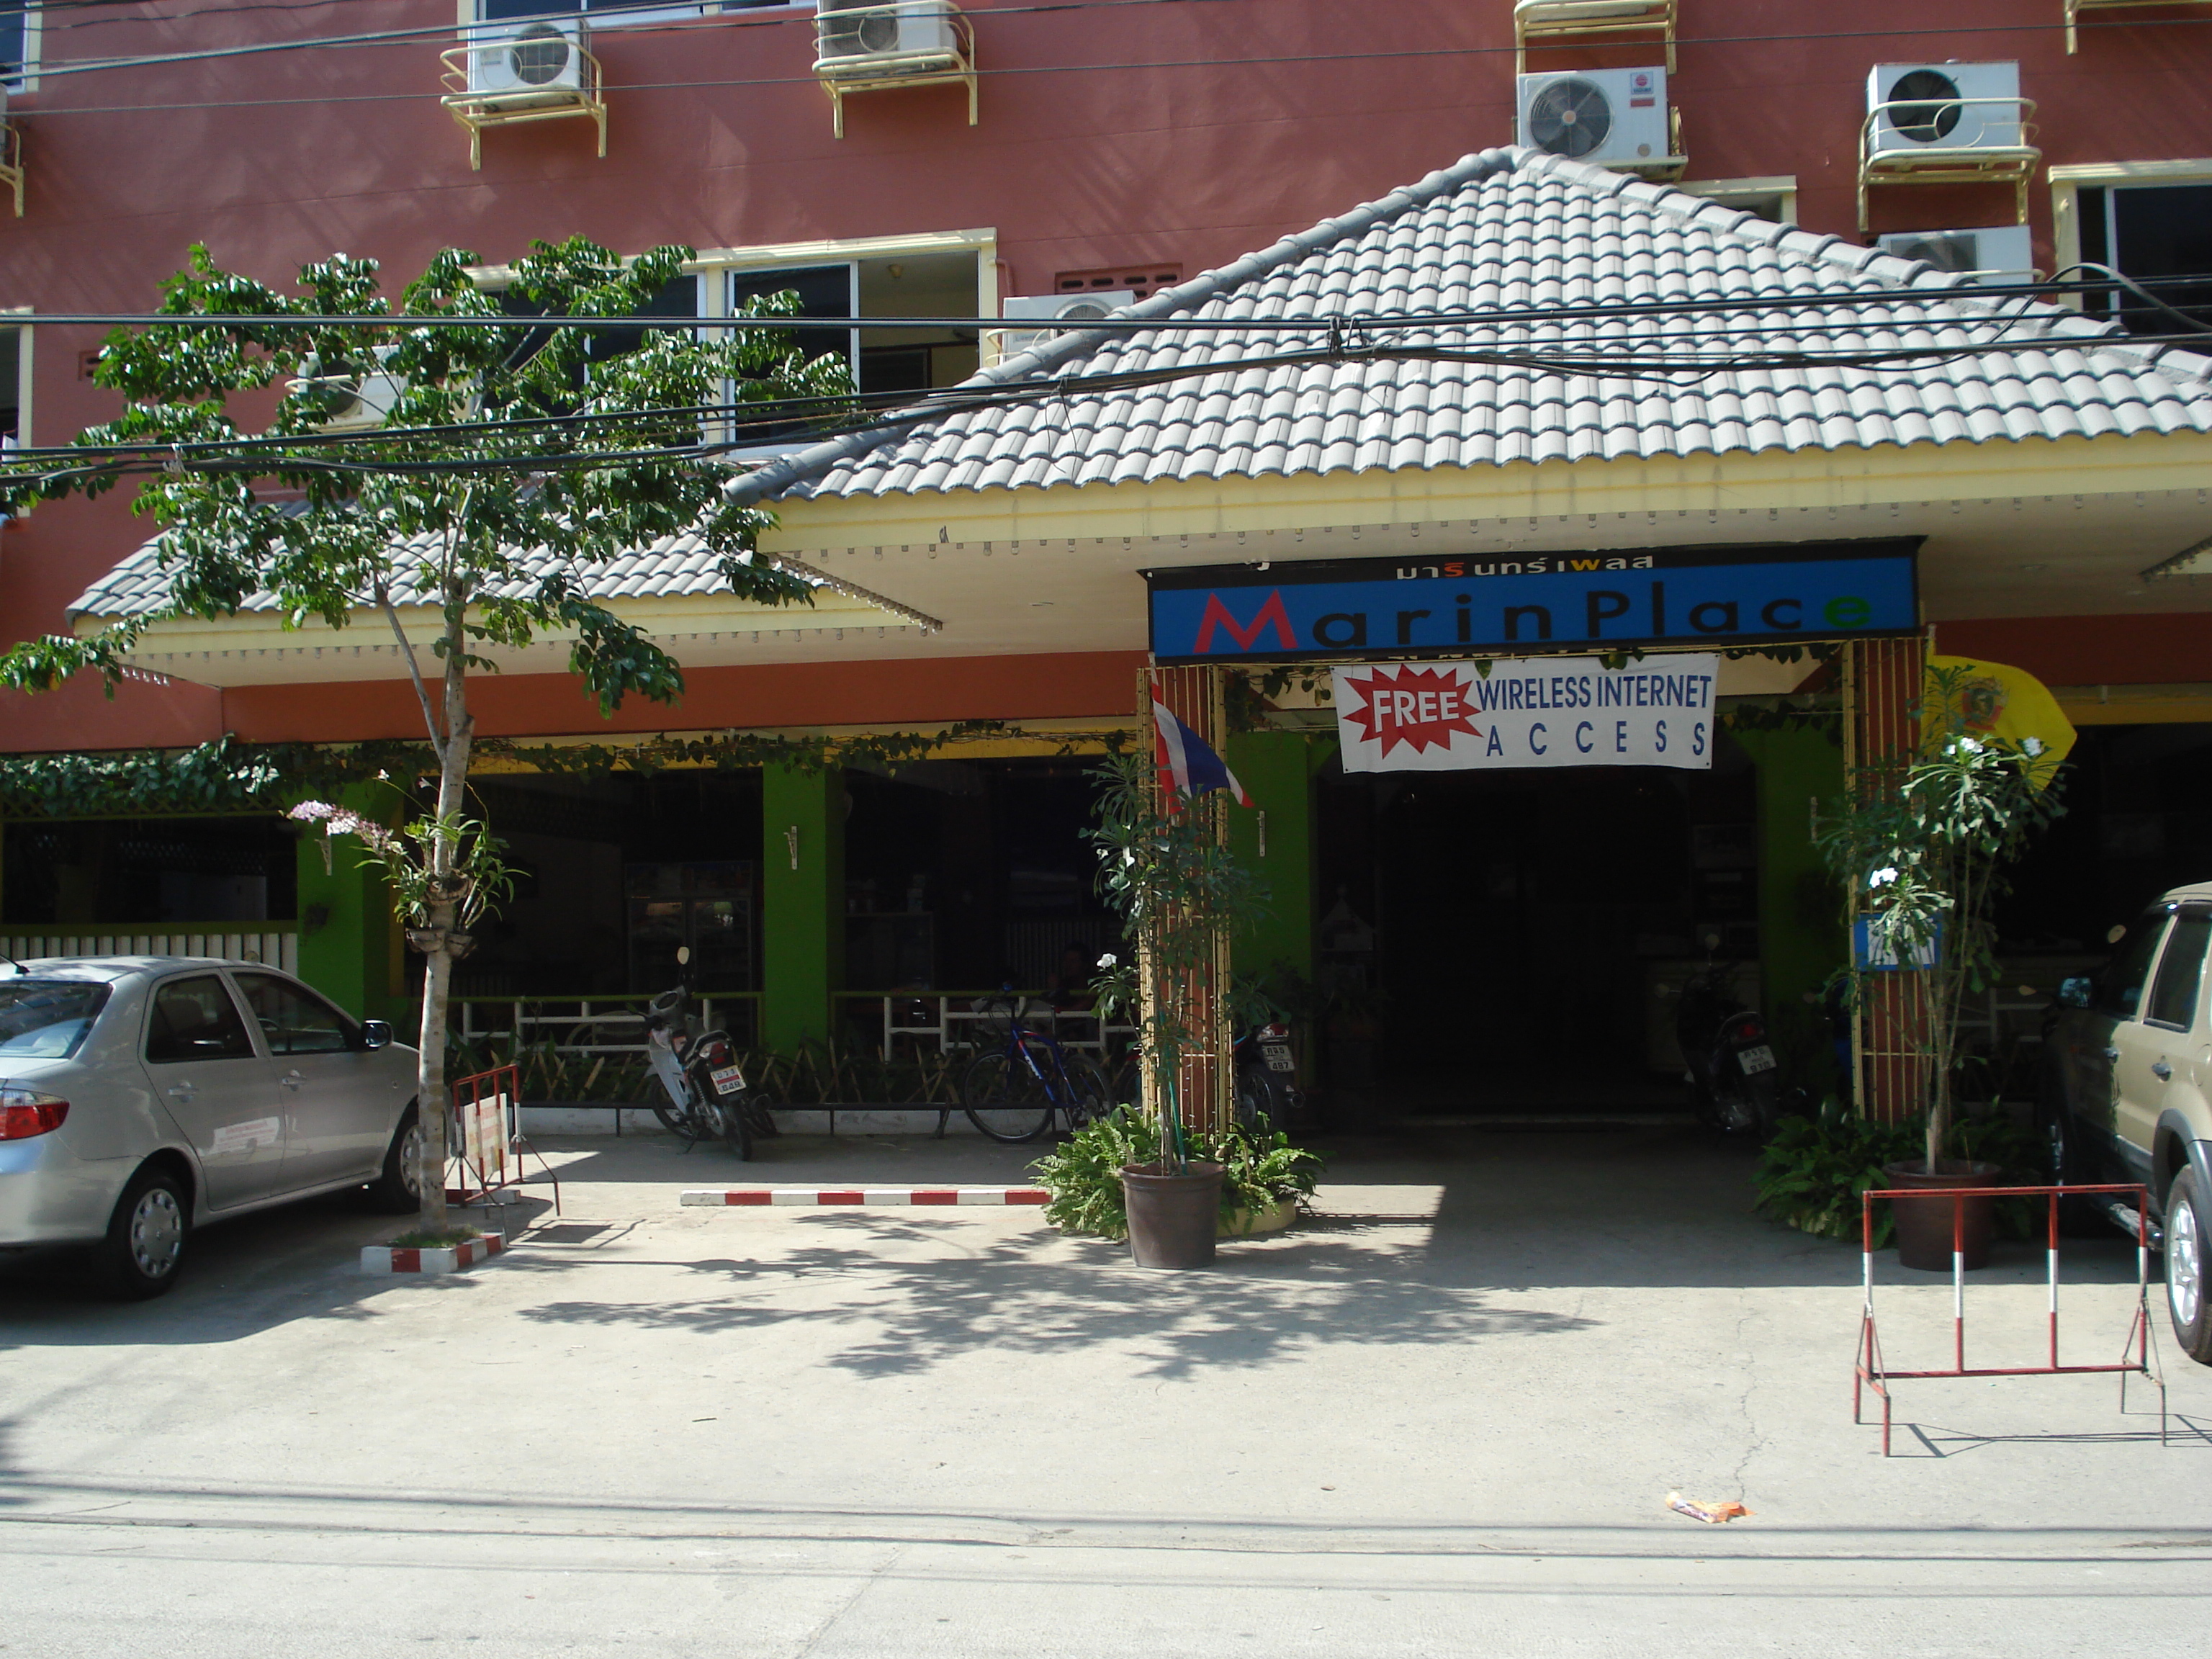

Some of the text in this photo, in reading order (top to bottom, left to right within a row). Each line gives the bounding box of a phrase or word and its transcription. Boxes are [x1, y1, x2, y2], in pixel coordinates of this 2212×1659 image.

[1395, 555, 1654, 580] มารินทร์เพลส
[1476, 675, 1712, 711] WIRELESS INTERNET
[1372, 689, 1460, 734] FREE
